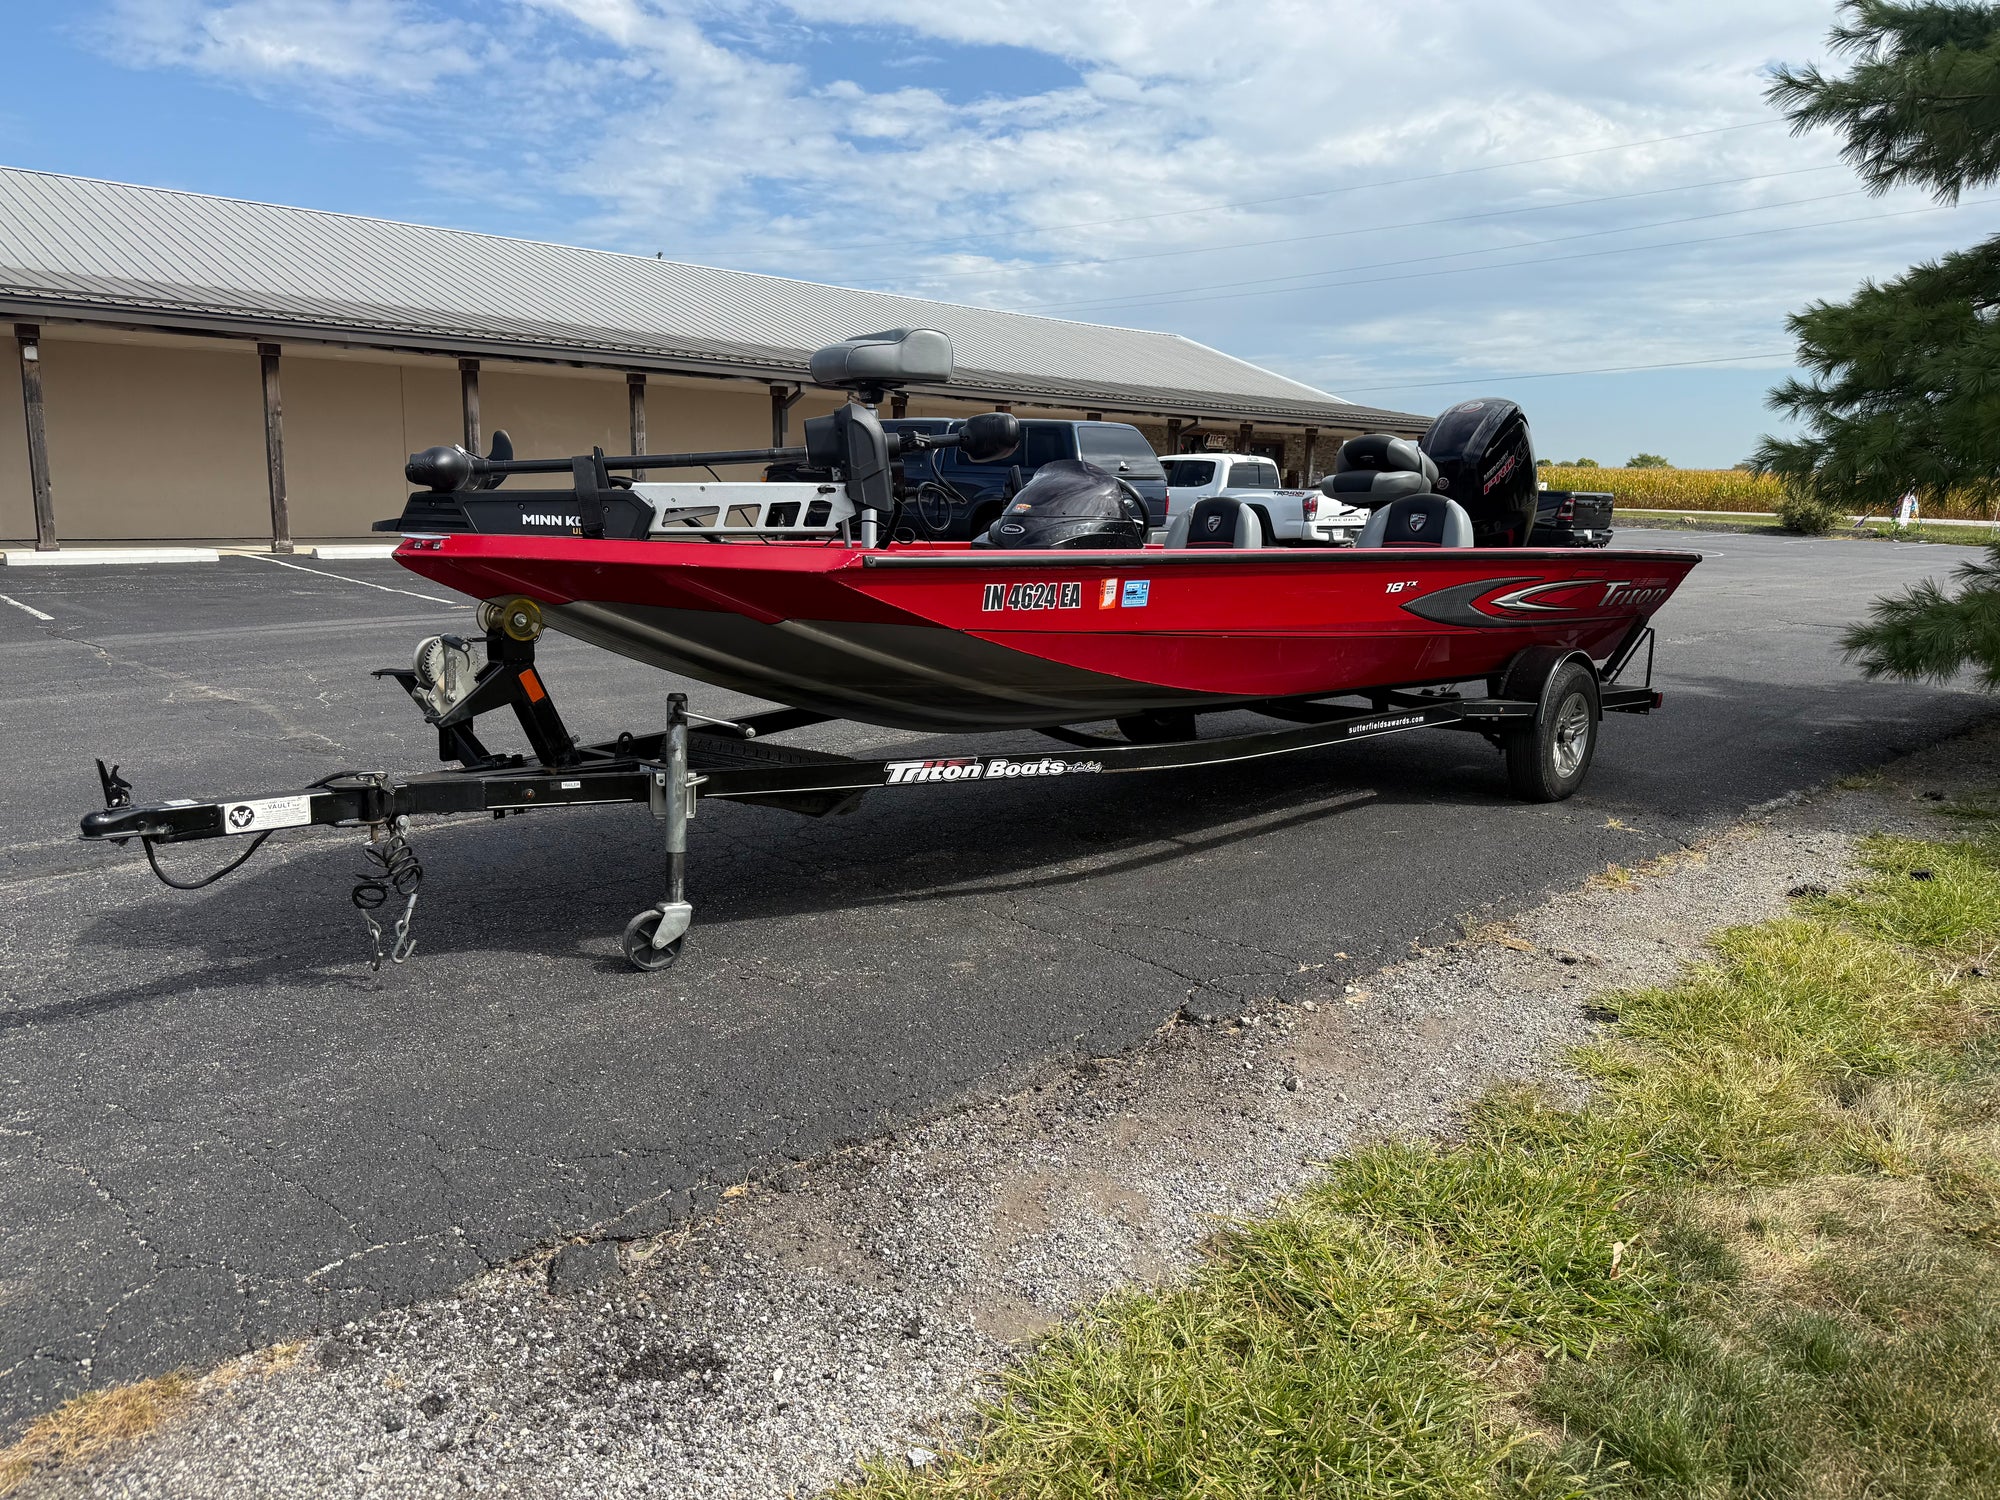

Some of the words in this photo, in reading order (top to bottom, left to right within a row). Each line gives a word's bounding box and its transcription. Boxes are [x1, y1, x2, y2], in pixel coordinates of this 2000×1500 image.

[522, 514, 562, 526] MINN
[982, 584, 1006, 611] IN
[1007, 582, 1057, 611] 4624
[1059, 582, 1081, 609] EA
[1385, 582, 1405, 594] 18
[1598, 581, 1667, 607] Triton
[1348, 716, 1424, 734] sutterfieldsawards.com
[887, 761, 981, 783] Triton
[986, 760, 1065, 777] Boats
[267, 802, 290, 810] VAULT
